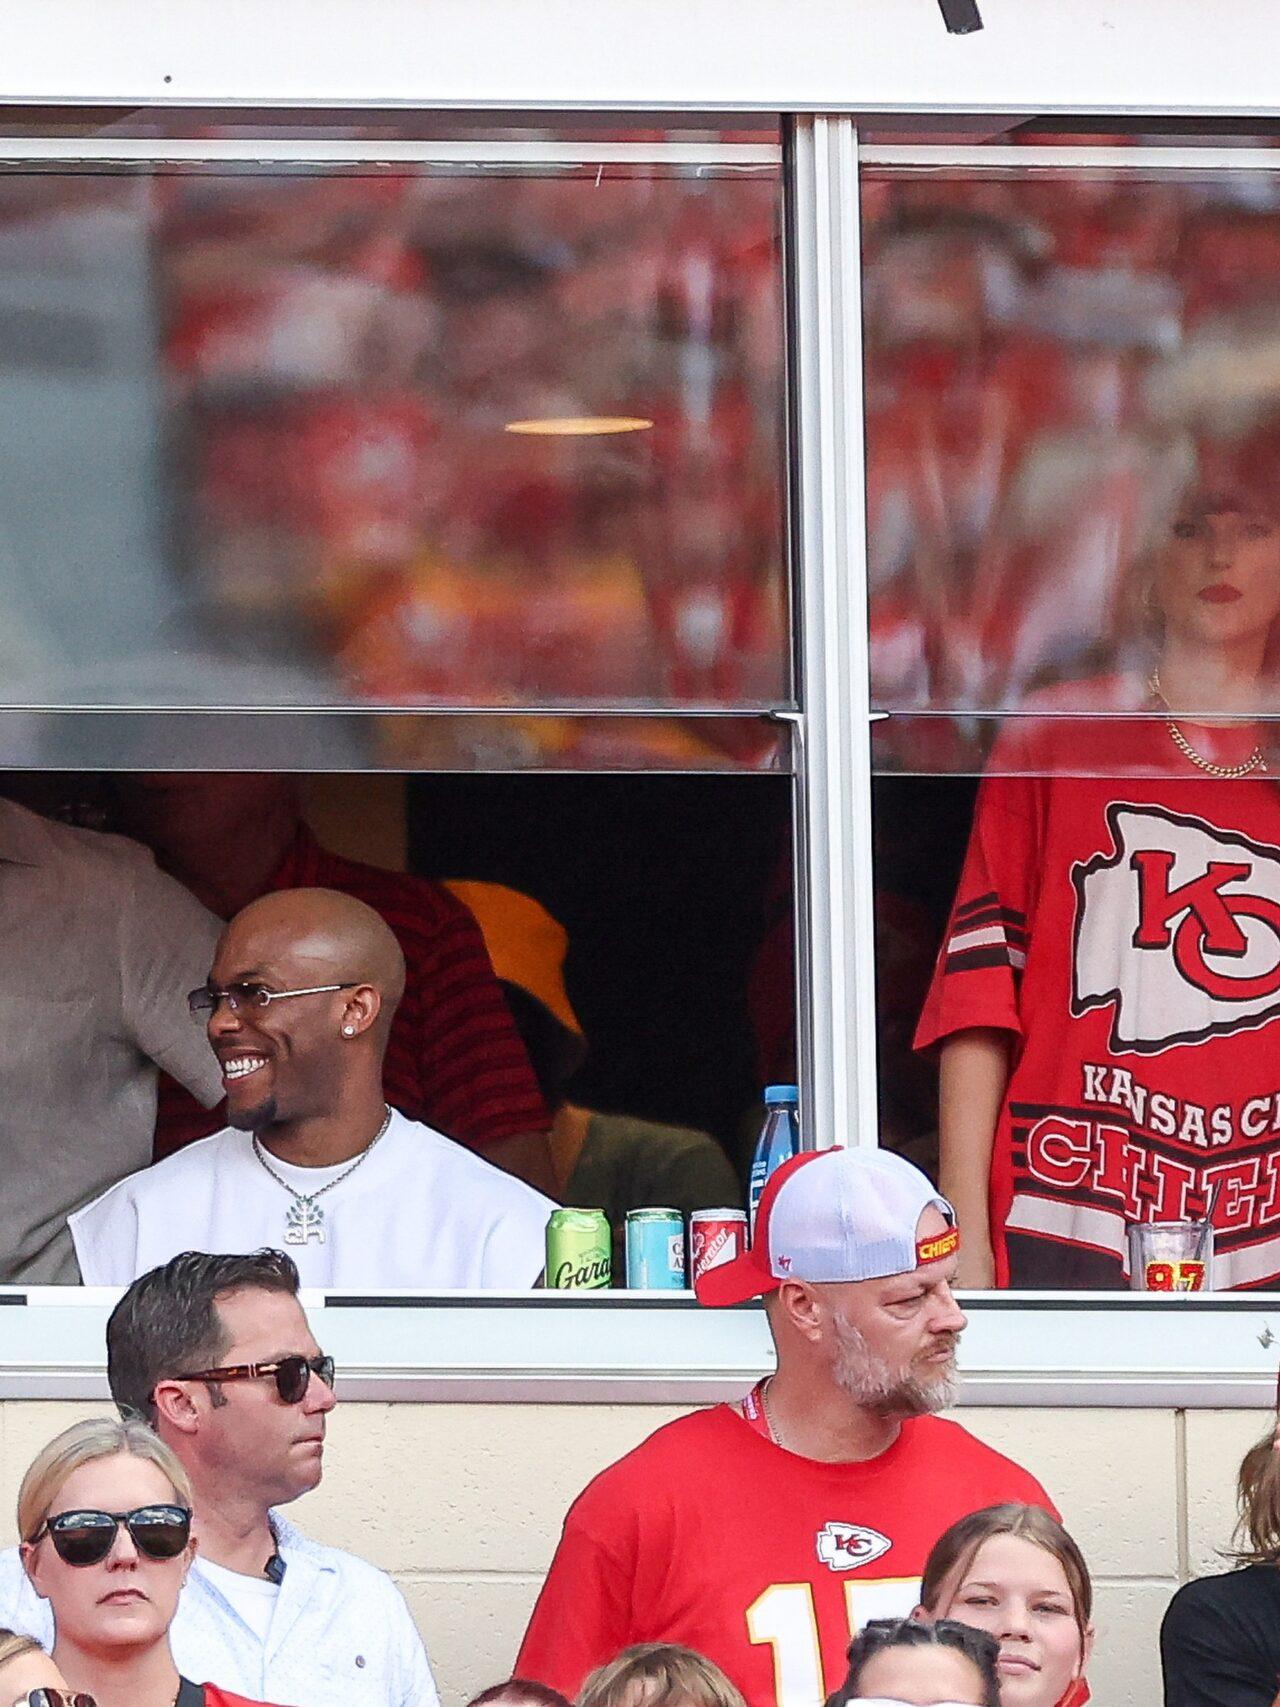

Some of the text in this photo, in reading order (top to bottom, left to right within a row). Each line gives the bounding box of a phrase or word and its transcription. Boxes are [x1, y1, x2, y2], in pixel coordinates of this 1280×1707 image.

[1083, 1063, 1233, 1148] KANSAS
[555, 1257, 610, 1289] Gara
[834, 1533, 873, 1557] KC
